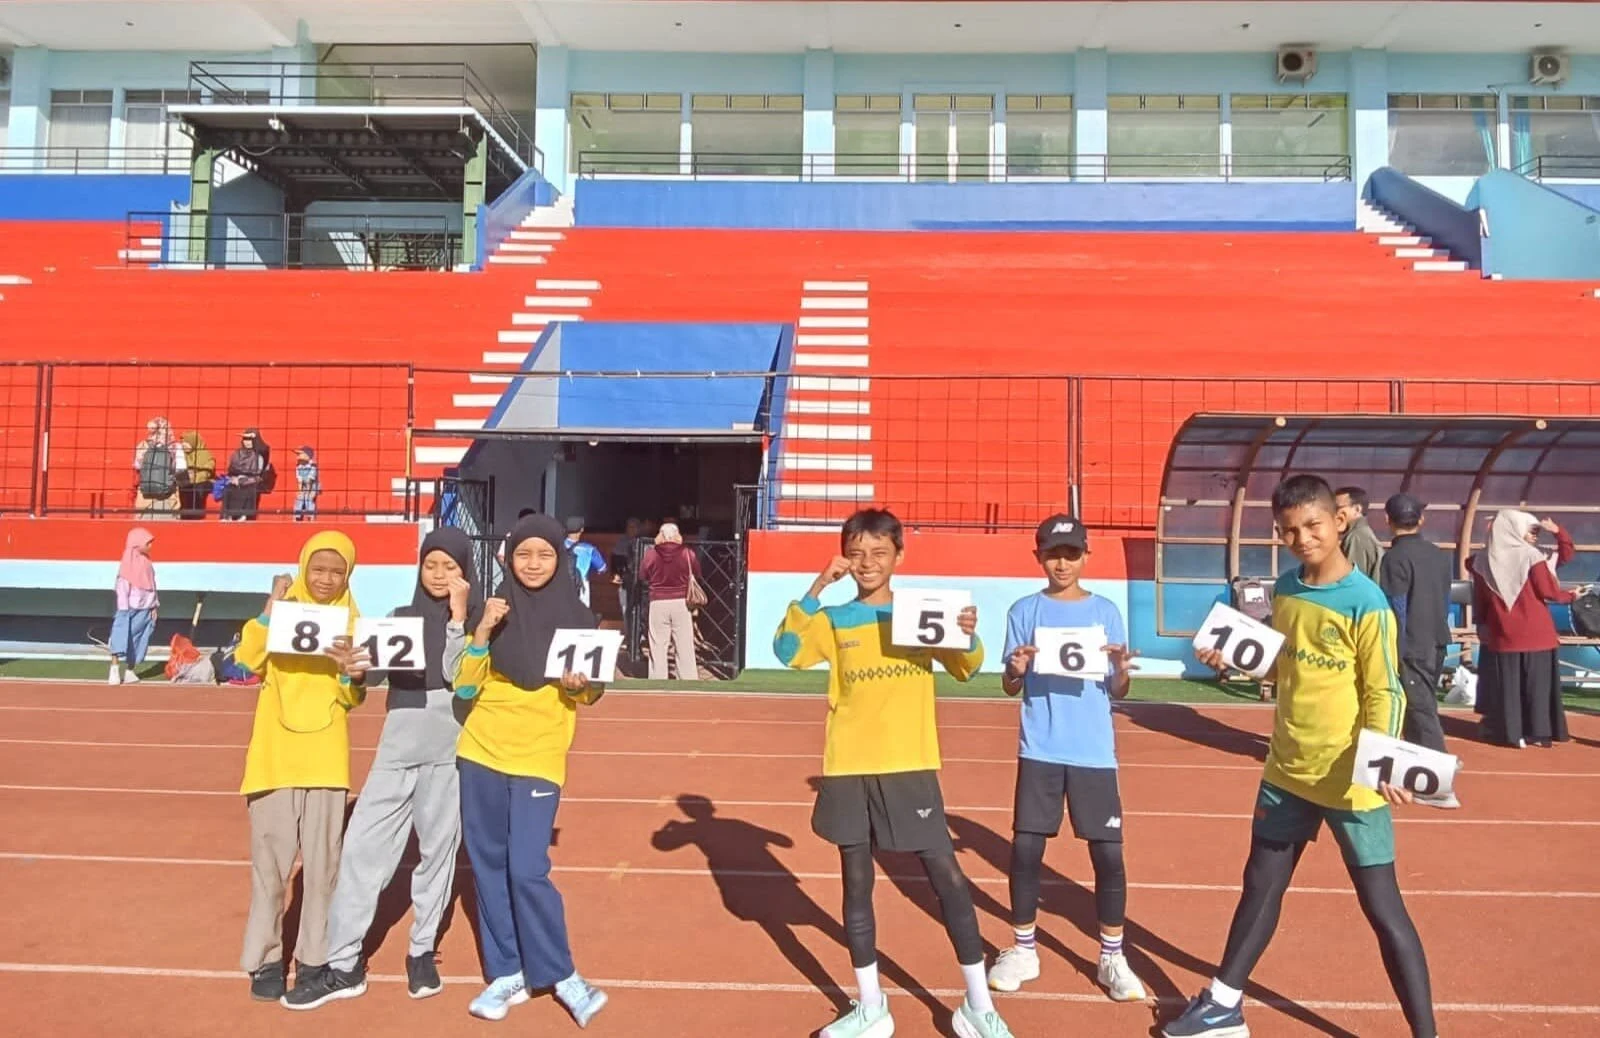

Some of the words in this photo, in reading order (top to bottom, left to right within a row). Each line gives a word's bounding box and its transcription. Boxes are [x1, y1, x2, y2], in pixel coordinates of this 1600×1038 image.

[291, 620, 320, 652] 8
[917, 610, 945, 645] 5
[360, 634, 415, 668] 12
[557, 644, 603, 678] 11
[1059, 642, 1086, 671] 6
[1209, 625, 1264, 671] 10
[1368, 755, 1439, 795] 10
